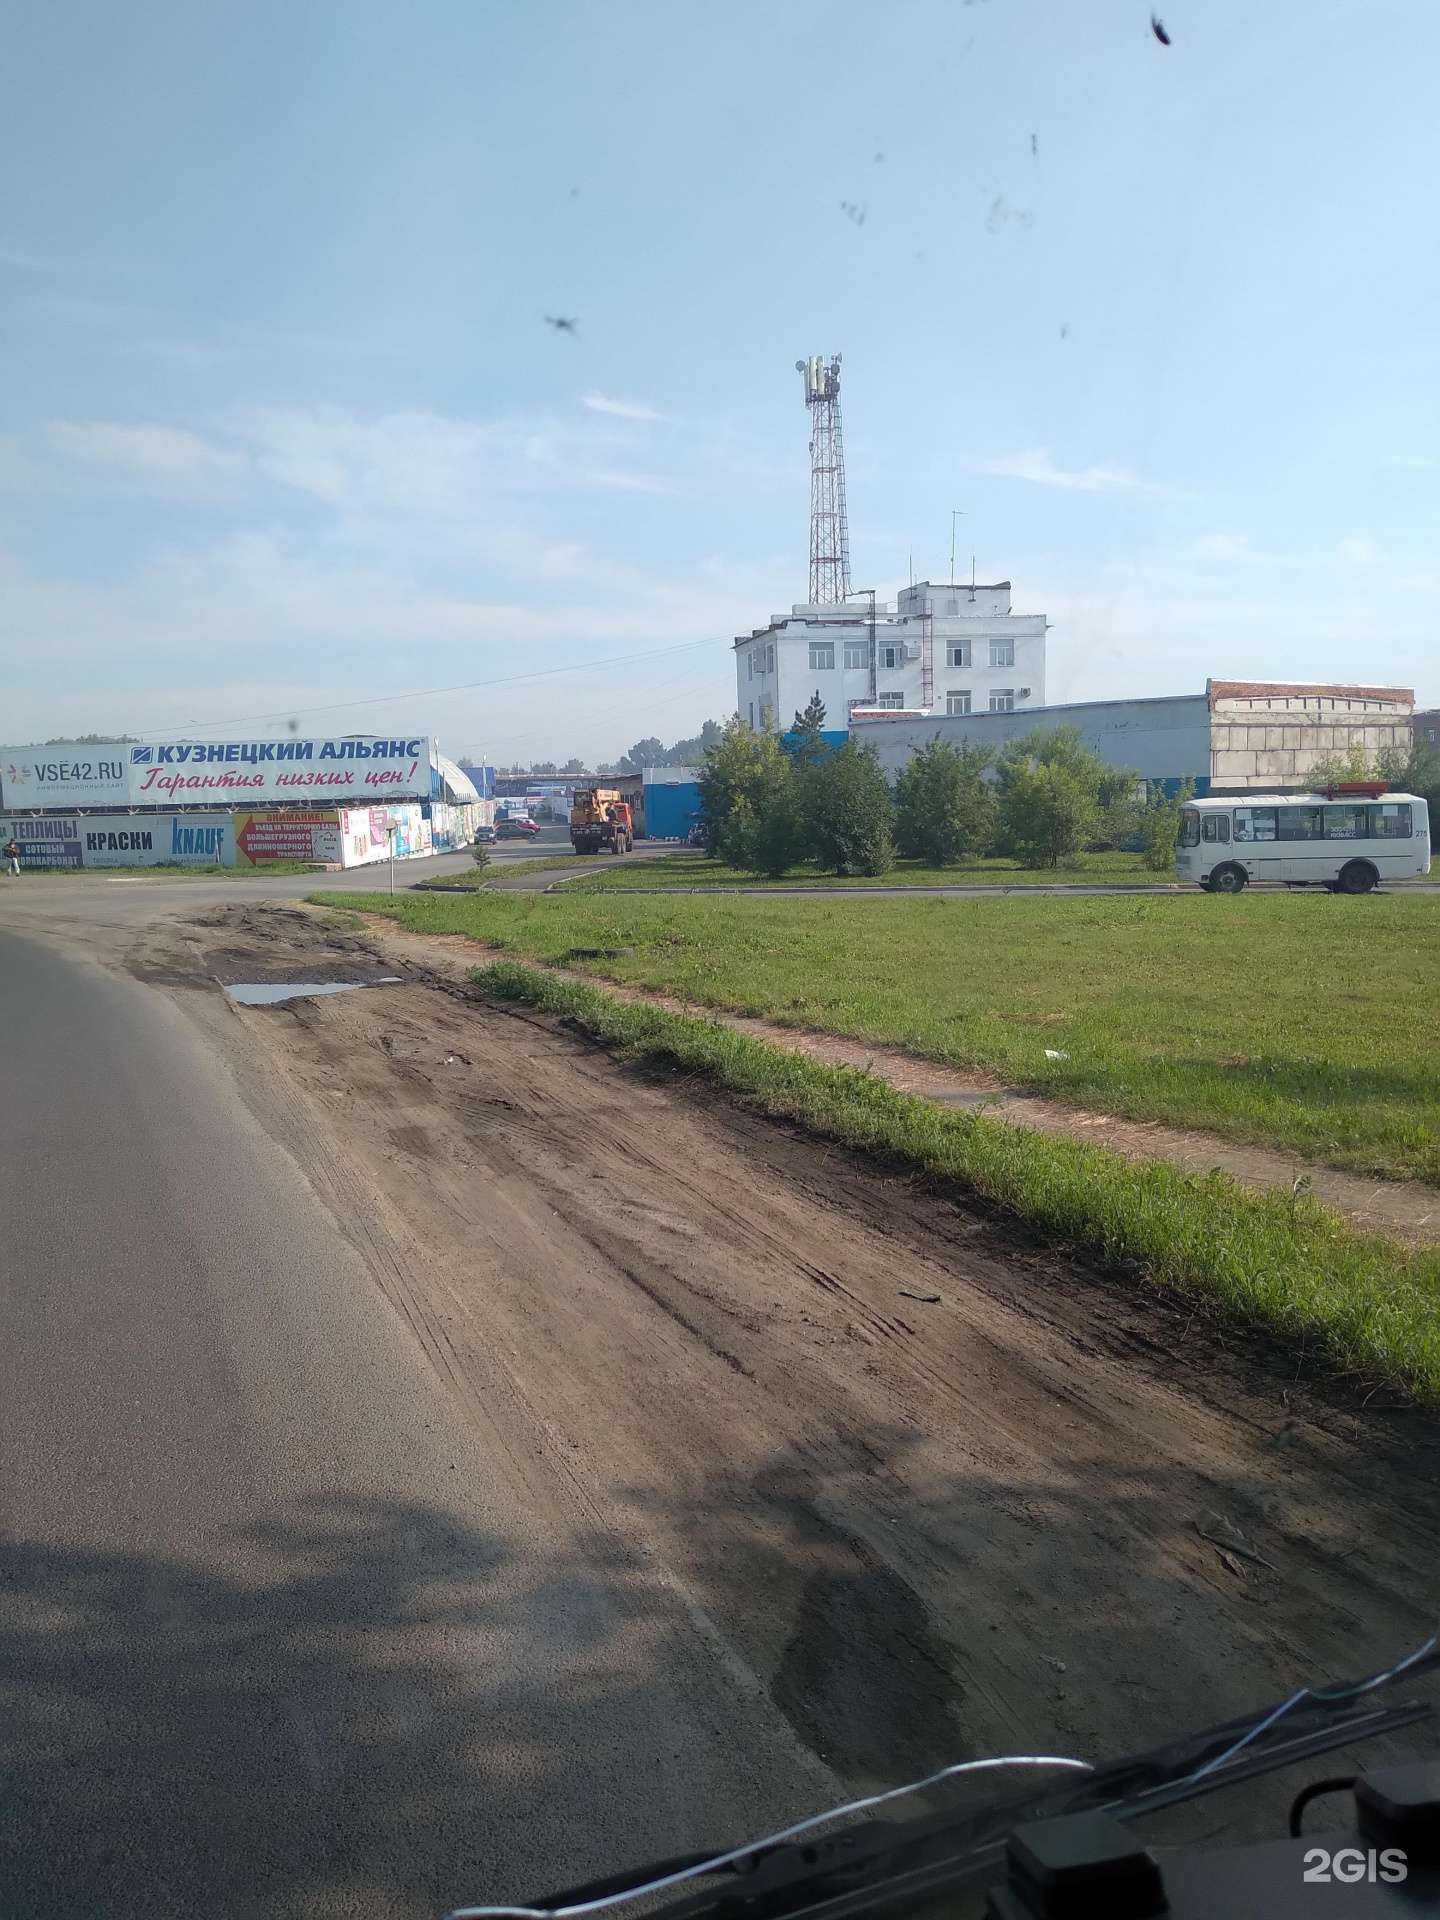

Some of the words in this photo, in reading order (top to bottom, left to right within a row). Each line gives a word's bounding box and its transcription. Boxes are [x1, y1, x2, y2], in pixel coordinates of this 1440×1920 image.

[157, 740, 314, 764] КУЗНЕЦКИЙ
[319, 740, 420, 760] АЛЬЯНС
[140, 767, 264, 797] Гарантия
[275, 771, 354, 786] низких
[364, 761, 418, 787] цен!
[11, 820, 78, 841] ТЕПЛИЦЫ
[86, 831, 153, 851] КРАСКИ
